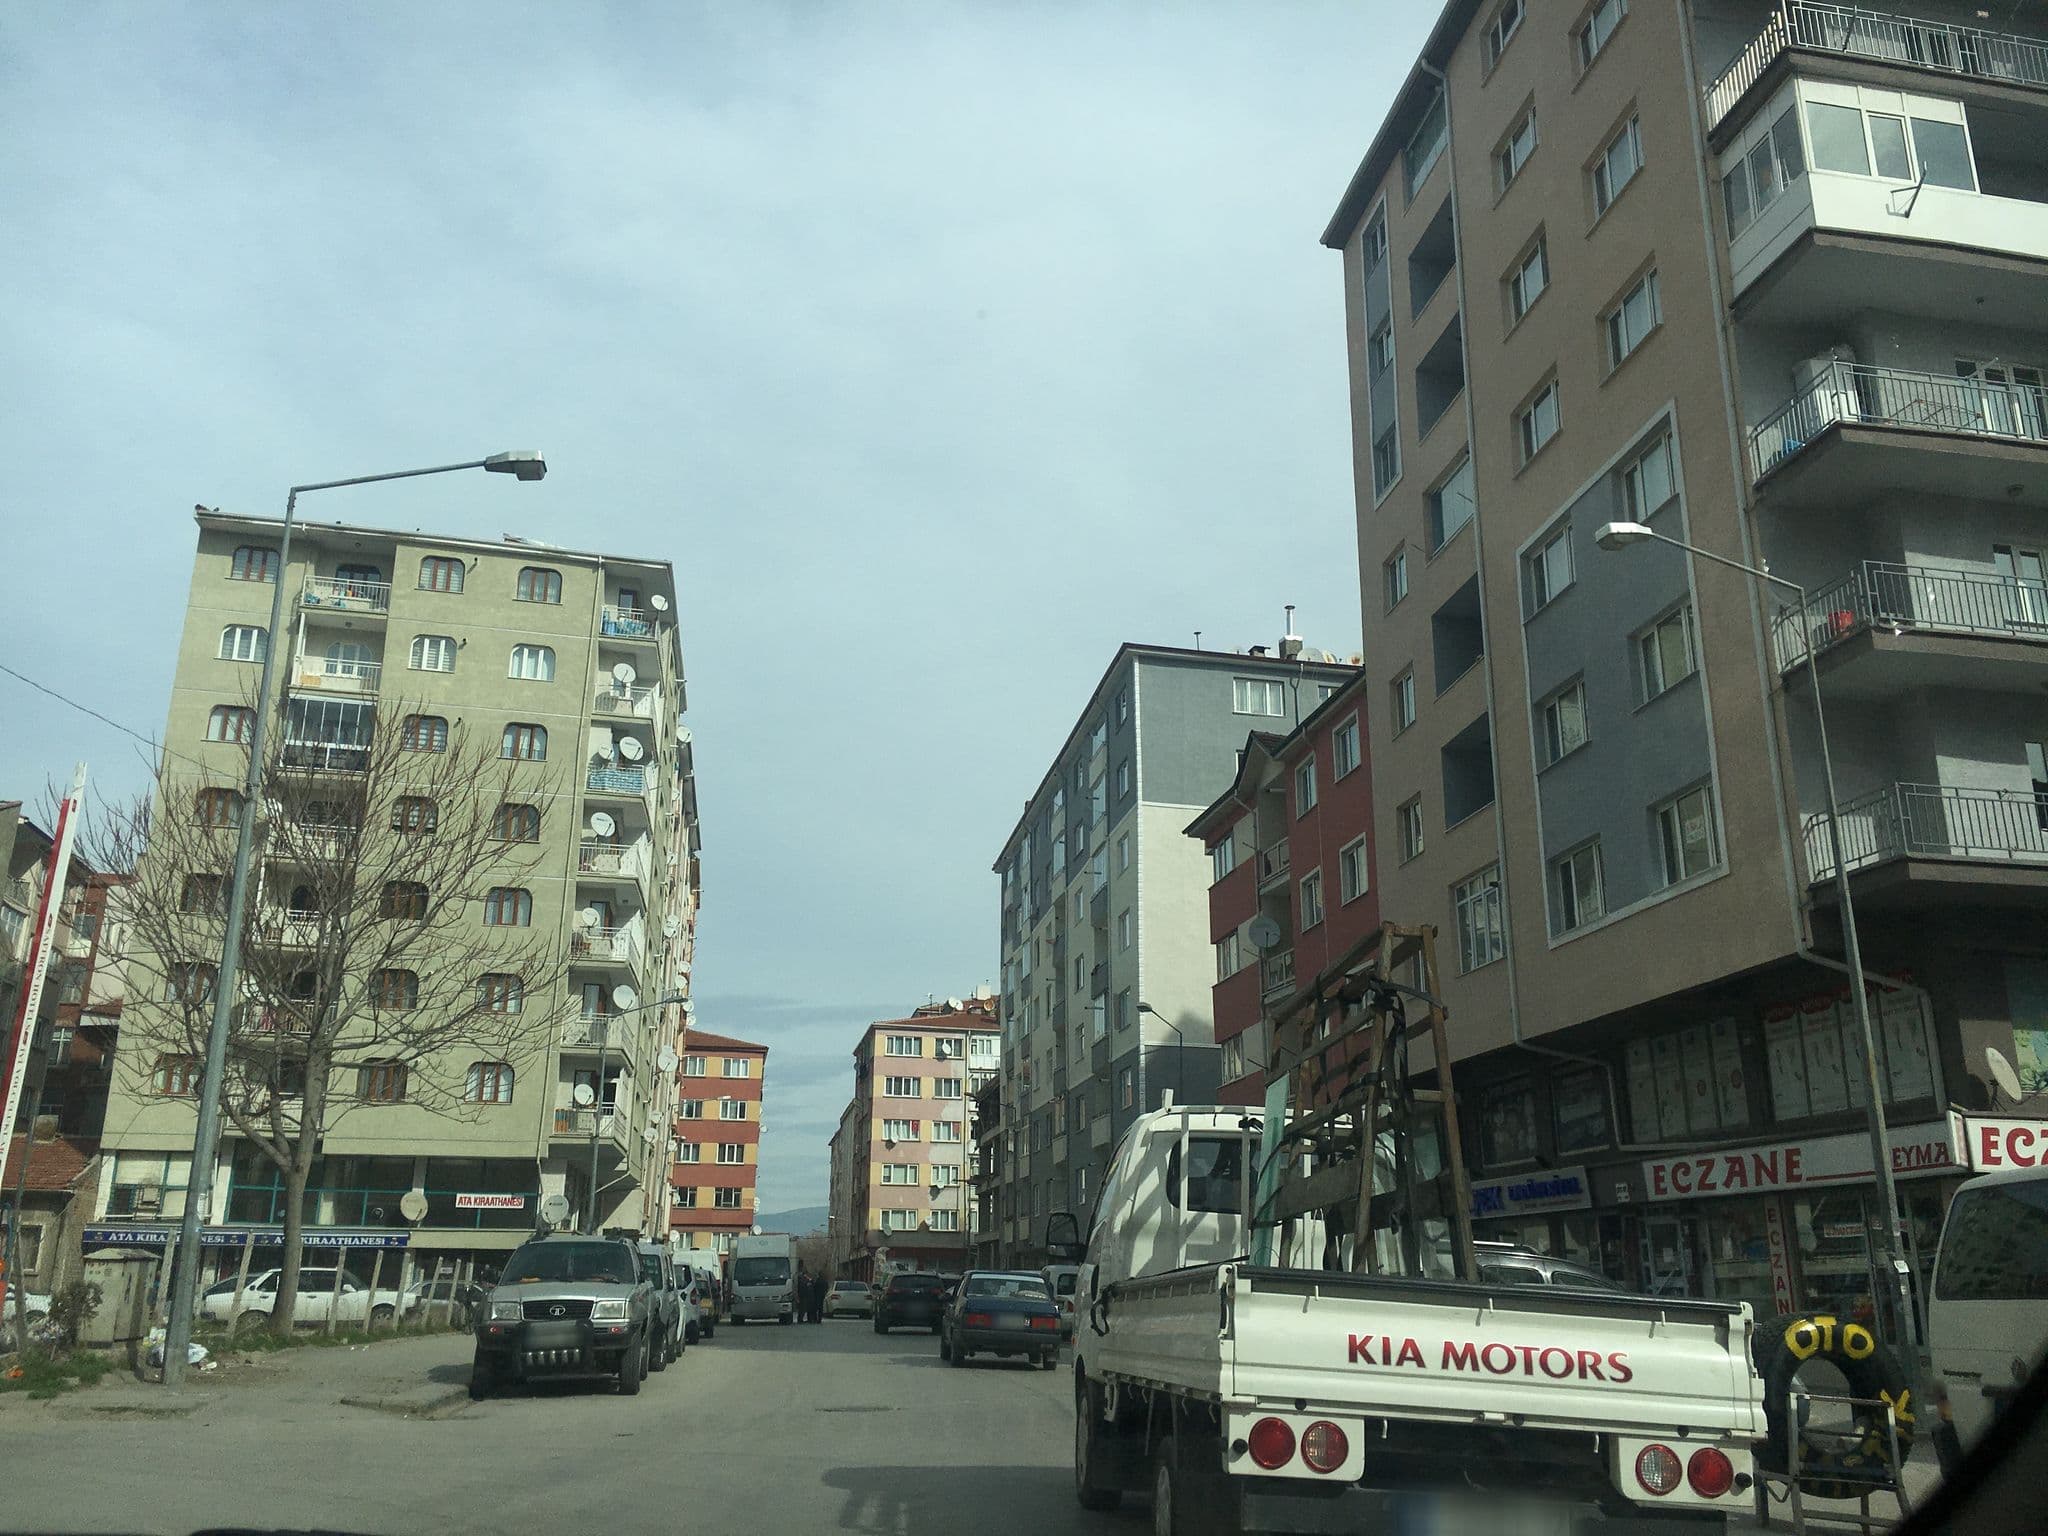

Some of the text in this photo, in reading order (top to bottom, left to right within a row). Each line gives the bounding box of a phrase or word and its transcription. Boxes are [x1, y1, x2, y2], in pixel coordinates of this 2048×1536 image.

[1652, 1148, 1802, 1196] ECZANE
[458, 1196, 472, 1206] ATA
[109, 1232, 134, 1242] ATA
[1347, 1334, 1634, 1383] KIA MOTORS
[1784, 1315, 1875, 1361] OTO
